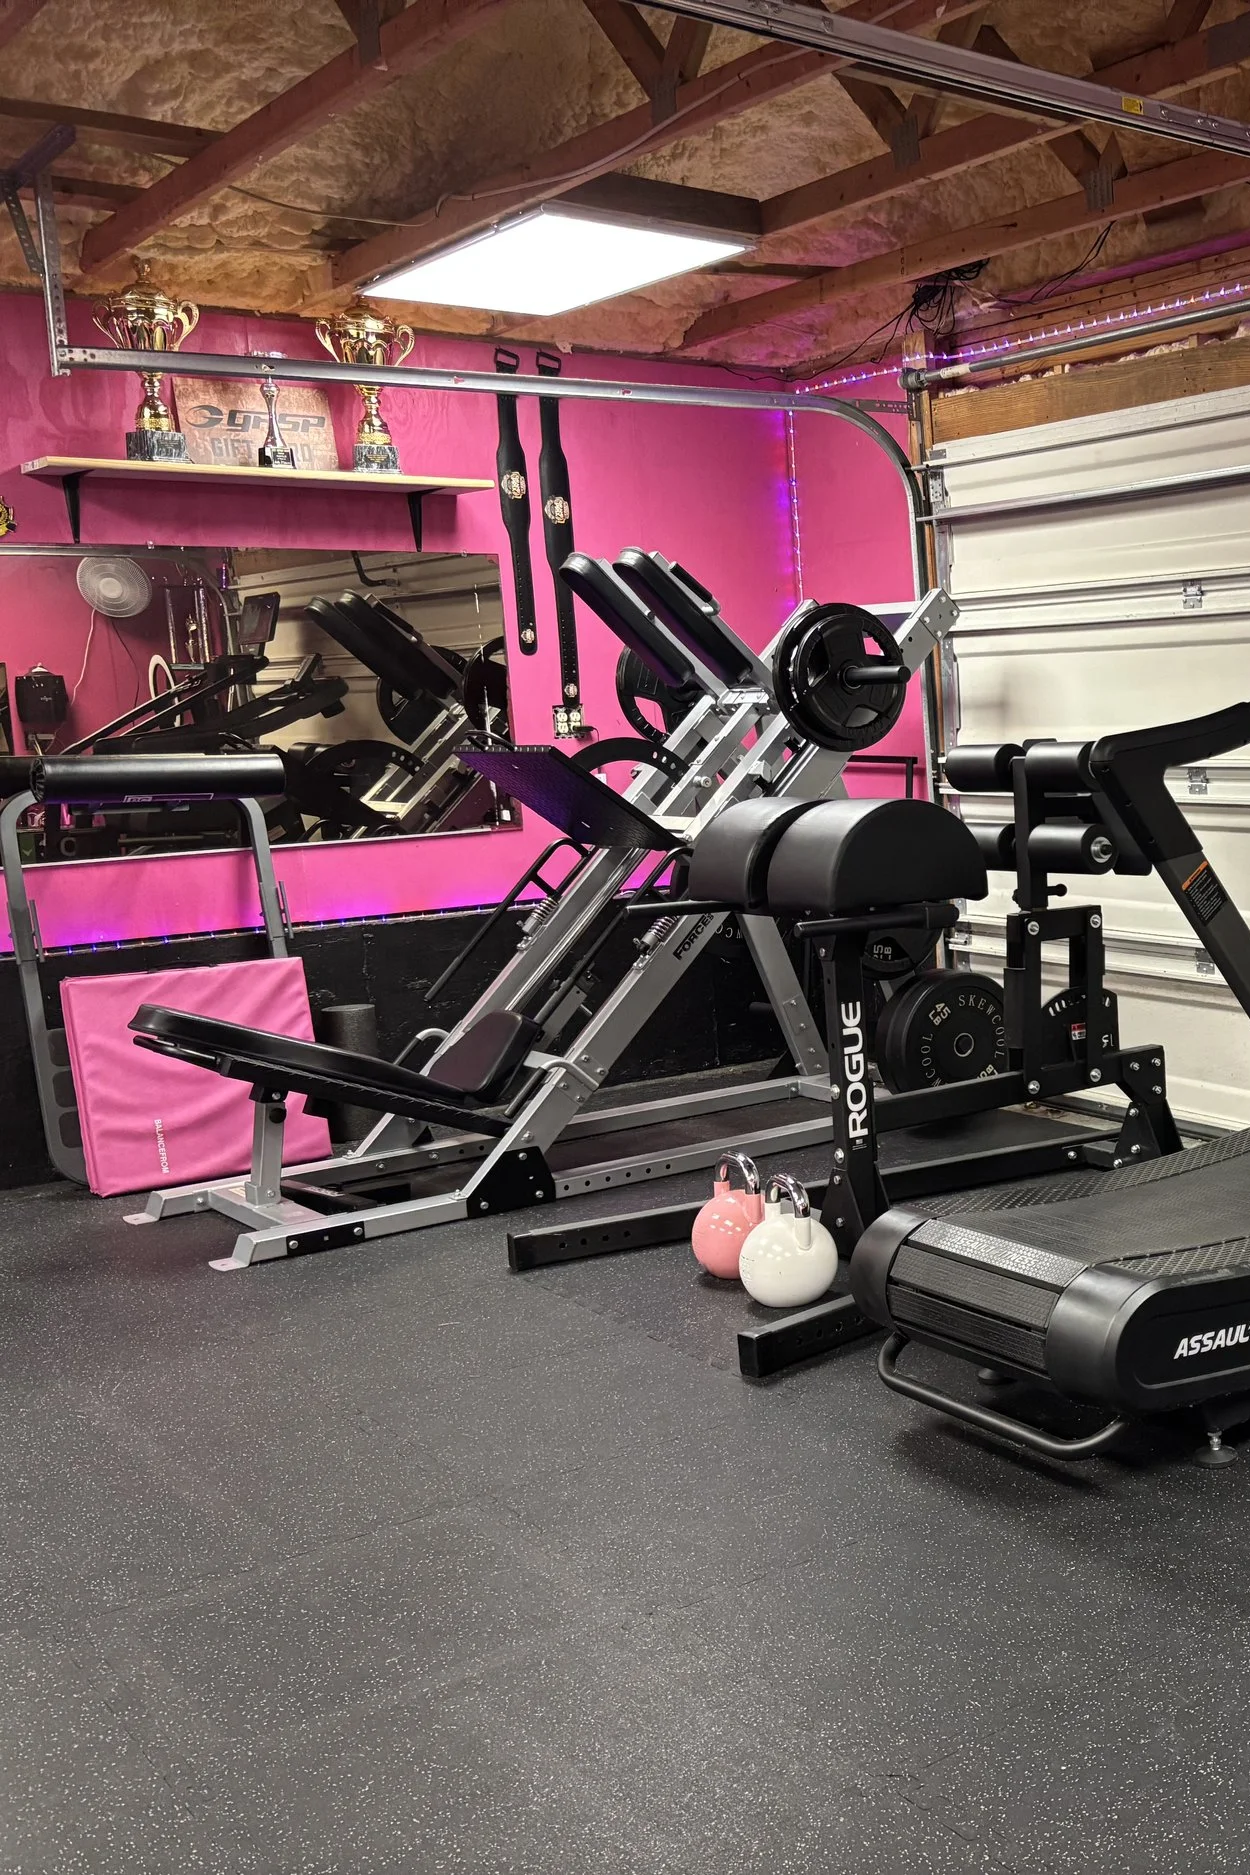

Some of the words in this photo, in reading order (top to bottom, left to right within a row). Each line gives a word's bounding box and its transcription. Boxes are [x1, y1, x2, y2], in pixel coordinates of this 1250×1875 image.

[211, 437, 253, 460] GIFT
[673, 913, 712, 961] FORCE
[928, 1010, 941, 1026] LB
[935, 1002, 951, 1019] 45
[958, 994, 1005, 1058] SKEWCOOL
[841, 1001, 868, 1139] ROGUE
[154, 1119, 170, 1174] BALANCEFROM
